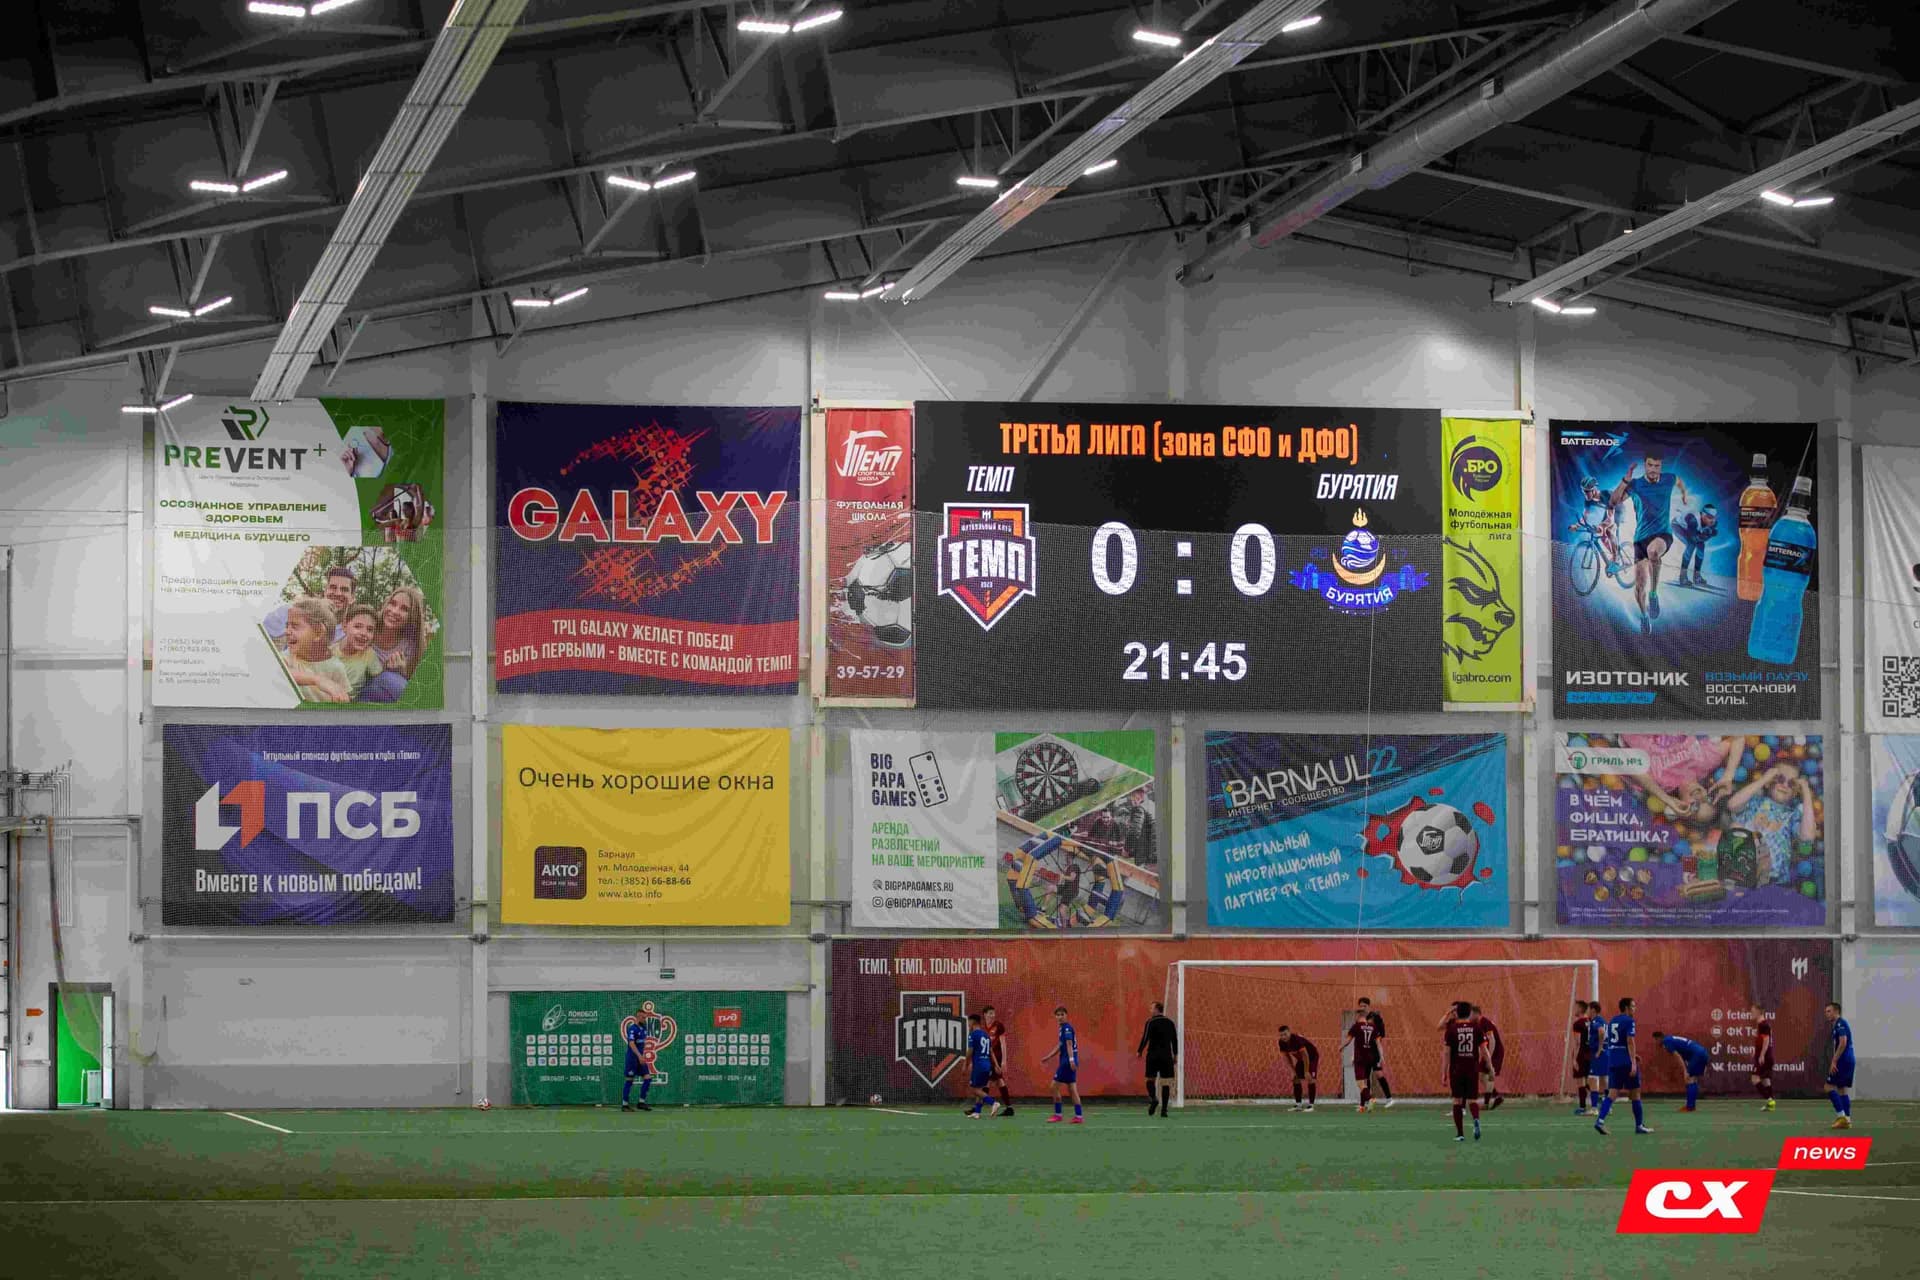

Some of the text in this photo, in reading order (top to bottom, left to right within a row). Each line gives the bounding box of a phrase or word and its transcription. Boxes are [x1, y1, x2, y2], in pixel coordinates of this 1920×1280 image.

[1000, 421, 1359, 464] ТРЕТЬЯ ЛИГА (зона СФО и ДФО)
[1560, 437, 1621, 446] BATTERADE
[966, 466, 1015, 492] ТЕМП
[1316, 473, 1399, 500] БУРЯТИЯ
[160, 500, 327, 512] ОСОЗНАННОЕ УПРАВЛЕНИЕ
[836, 501, 904, 510] ФУТБОЛЬНАЯ
[206, 514, 284, 524] ЗДОРОВЬЕМ
[507, 487, 788, 544] GALAXY
[851, 512, 887, 521] ШКОЛА
[1450, 520, 1512, 530] футбольная
[174, 530, 311, 542] МЕДИЦИНА БУДУЩЕГО
[1488, 533, 1512, 541] лига
[948, 540, 1026, 582] ТЕМП
[1091, 521, 1138, 596] 0
[1230, 522, 1277, 597] 0
[1325, 586, 1394, 605] БУРЯТИЯ
[552, 619, 734, 651] ТРЦ GALAXY ЖЕЛАЕТ ПОБЕД!
[504, 645, 538, 666] БЫТЬ
[542, 641, 605, 659] ПЕРВЫМИ
[619, 645, 667, 667] ВМЕСТЕ
[671, 651, 679, 668] С
[683, 650, 753, 675] КОМАНДОЙ
[757, 654, 792, 673] ТЕМП!
[1122, 641, 1248, 681] 21:45
[836, 665, 905, 681] 39-57-29
[1452, 671, 1512, 686] ligabro.com
[1566, 670, 1690, 687] ИЗОТОНИК
[1705, 671, 1762, 682] ВОЗЬМИ
[1705, 684, 1797, 694] ВОССТАНОВИ
[1706, 695, 1749, 705] СИЛЫ.
[871, 753, 893, 770] BIG
[1591, 757, 1624, 766] ГРИЛЬ
[519, 767, 775, 795] Очень хорошие окна
[871, 771, 905, 789] PAPA
[871, 789, 917, 807] GAMES
[1226, 786, 1346, 818] ИНТЕРНЕТ СООБЩЕСТВО
[1569, 789, 1622, 807] В ЧЁМ
[286, 790, 421, 840] ПСБ
[1569, 812, 1644, 827] ФИШКА,
[871, 822, 910, 836] АРЕНДА
[1570, 829, 1669, 843] БРАТИШКА?
[871, 837, 940, 852] РАЗВЛЕЧЕНИЙ
[1224, 831, 1311, 864] ГЕНЕРАЛЬНЫЙ
[598, 850, 636, 859] Барнаул
[871, 854, 986, 869] НА ВАШЕ МЕРОПРИЯТИЕ
[598, 865, 611, 873] ул.
[678, 864, 690, 872] 44
[1225, 848, 1342, 888] ИНФОРМАЦИОННЫЙ
[196, 867, 422, 894] Вместе к новым победам!
[620, 877, 650, 886] (3852)
[651, 877, 692, 886] 66-88-66
[884, 880, 954, 893] BIGPAPAGAMES.RU
[598, 889, 663, 899] www.akto.info
[1223, 871, 1350, 911] ПАРТНЕР ФК «ТЕМП»
[885, 897, 954, 910] @BIGPAPAGAMES
[643, 947, 651, 963] 1
[859, 958, 1008, 977] ТЕМП, ТЕМП, ТОЛЬКО ТЕМП!
[903, 1018, 962, 1050] ТЕМП
[1363, 1029, 1373, 1045] 17
[1610, 1023, 1619, 1043] 5
[1726, 1026, 1743, 1037] ФК
[980, 1036, 990, 1055] 91
[1457, 1033, 1474, 1053] 23
